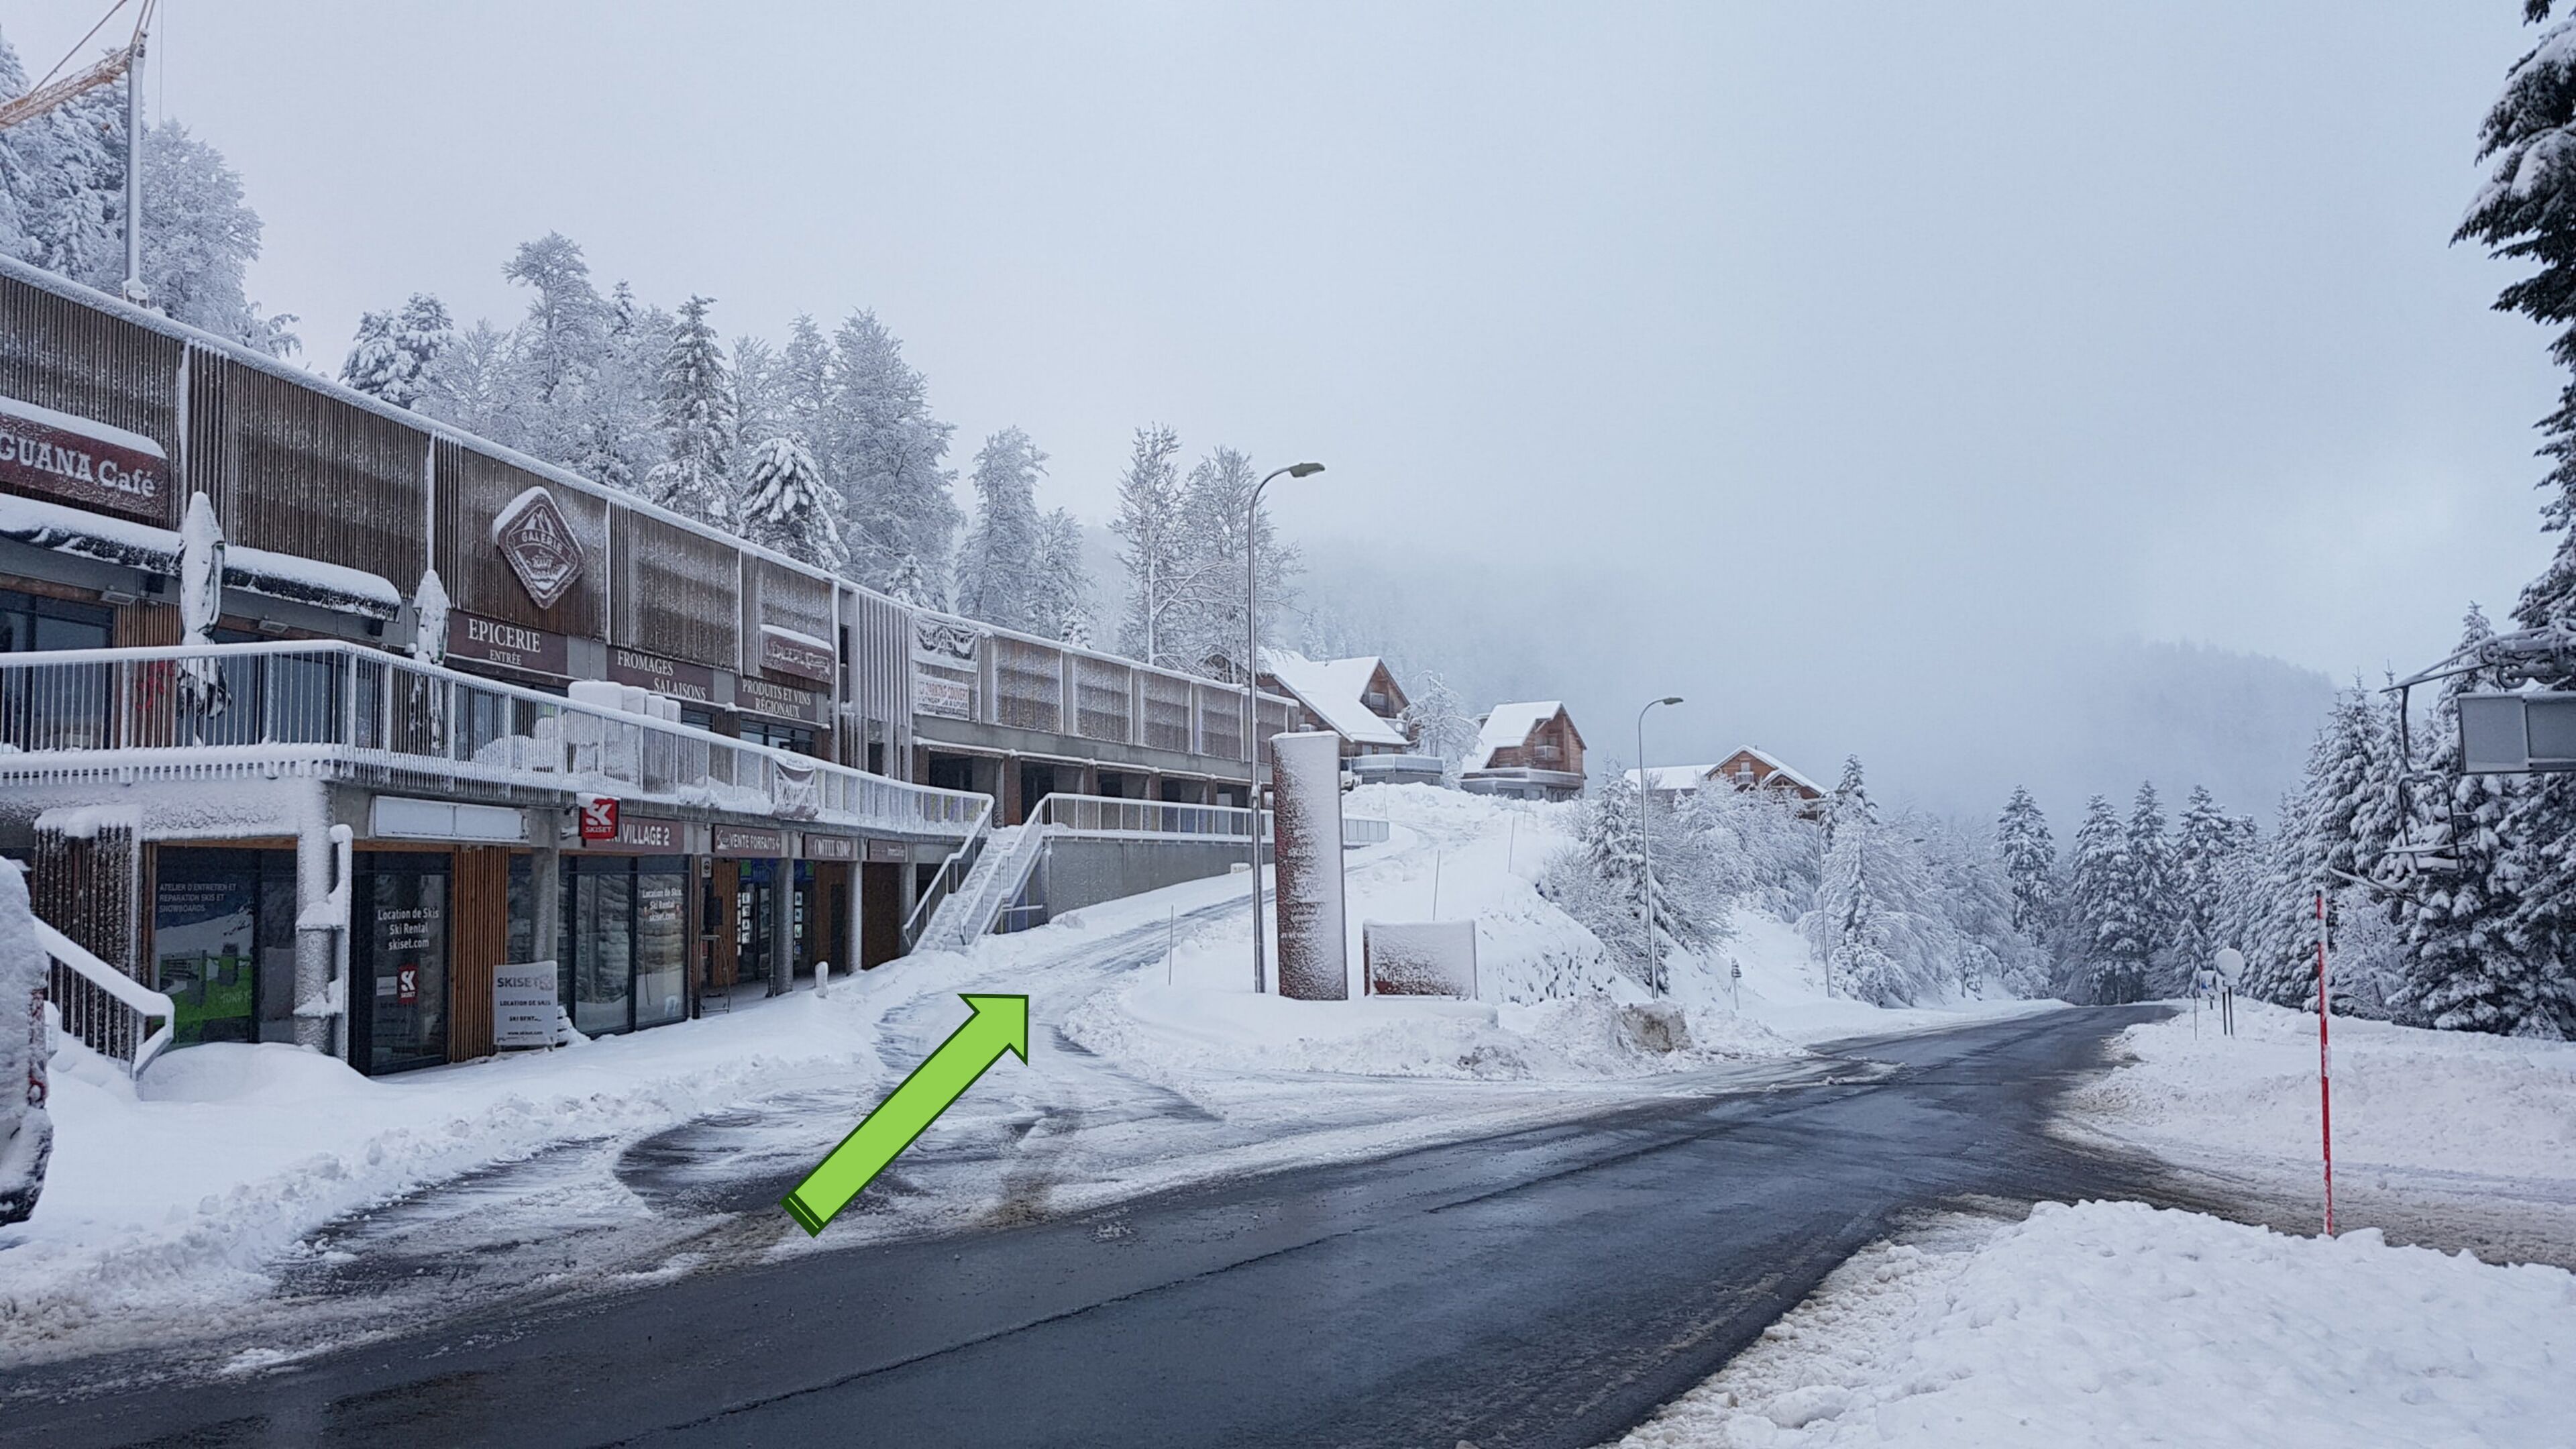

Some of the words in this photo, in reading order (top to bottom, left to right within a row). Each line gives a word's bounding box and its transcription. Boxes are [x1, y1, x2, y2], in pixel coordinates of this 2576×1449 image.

[98, 460, 156, 498] Café
[521, 531, 564, 554] GALERIE
[468, 618, 541, 653] EPICERIE
[490, 649, 522, 665] ENTRÉE
[617, 650, 674, 677] FROMAGES
[654, 678, 706, 701] SALAISONS
[743, 679, 783, 700] PRODUITS
[783, 688, 792, 702] ET
[794, 690, 811, 706] VINS
[755, 696, 800, 718] RÉGIONAUX
[622, 823, 662, 846] VILLAGE
[663, 826, 670, 847] 2
[729, 833, 750, 849] VENTE
[750, 835, 776, 851] FORFAITS
[228, 883, 236, 891] ET
[378, 909, 411, 920] Location
[412, 908, 422, 918] de
[423, 907, 439, 918] Skis
[390, 924, 402, 935] Ski
[404, 922, 428, 934] Rental
[389, 938, 429, 950] skiset.com
